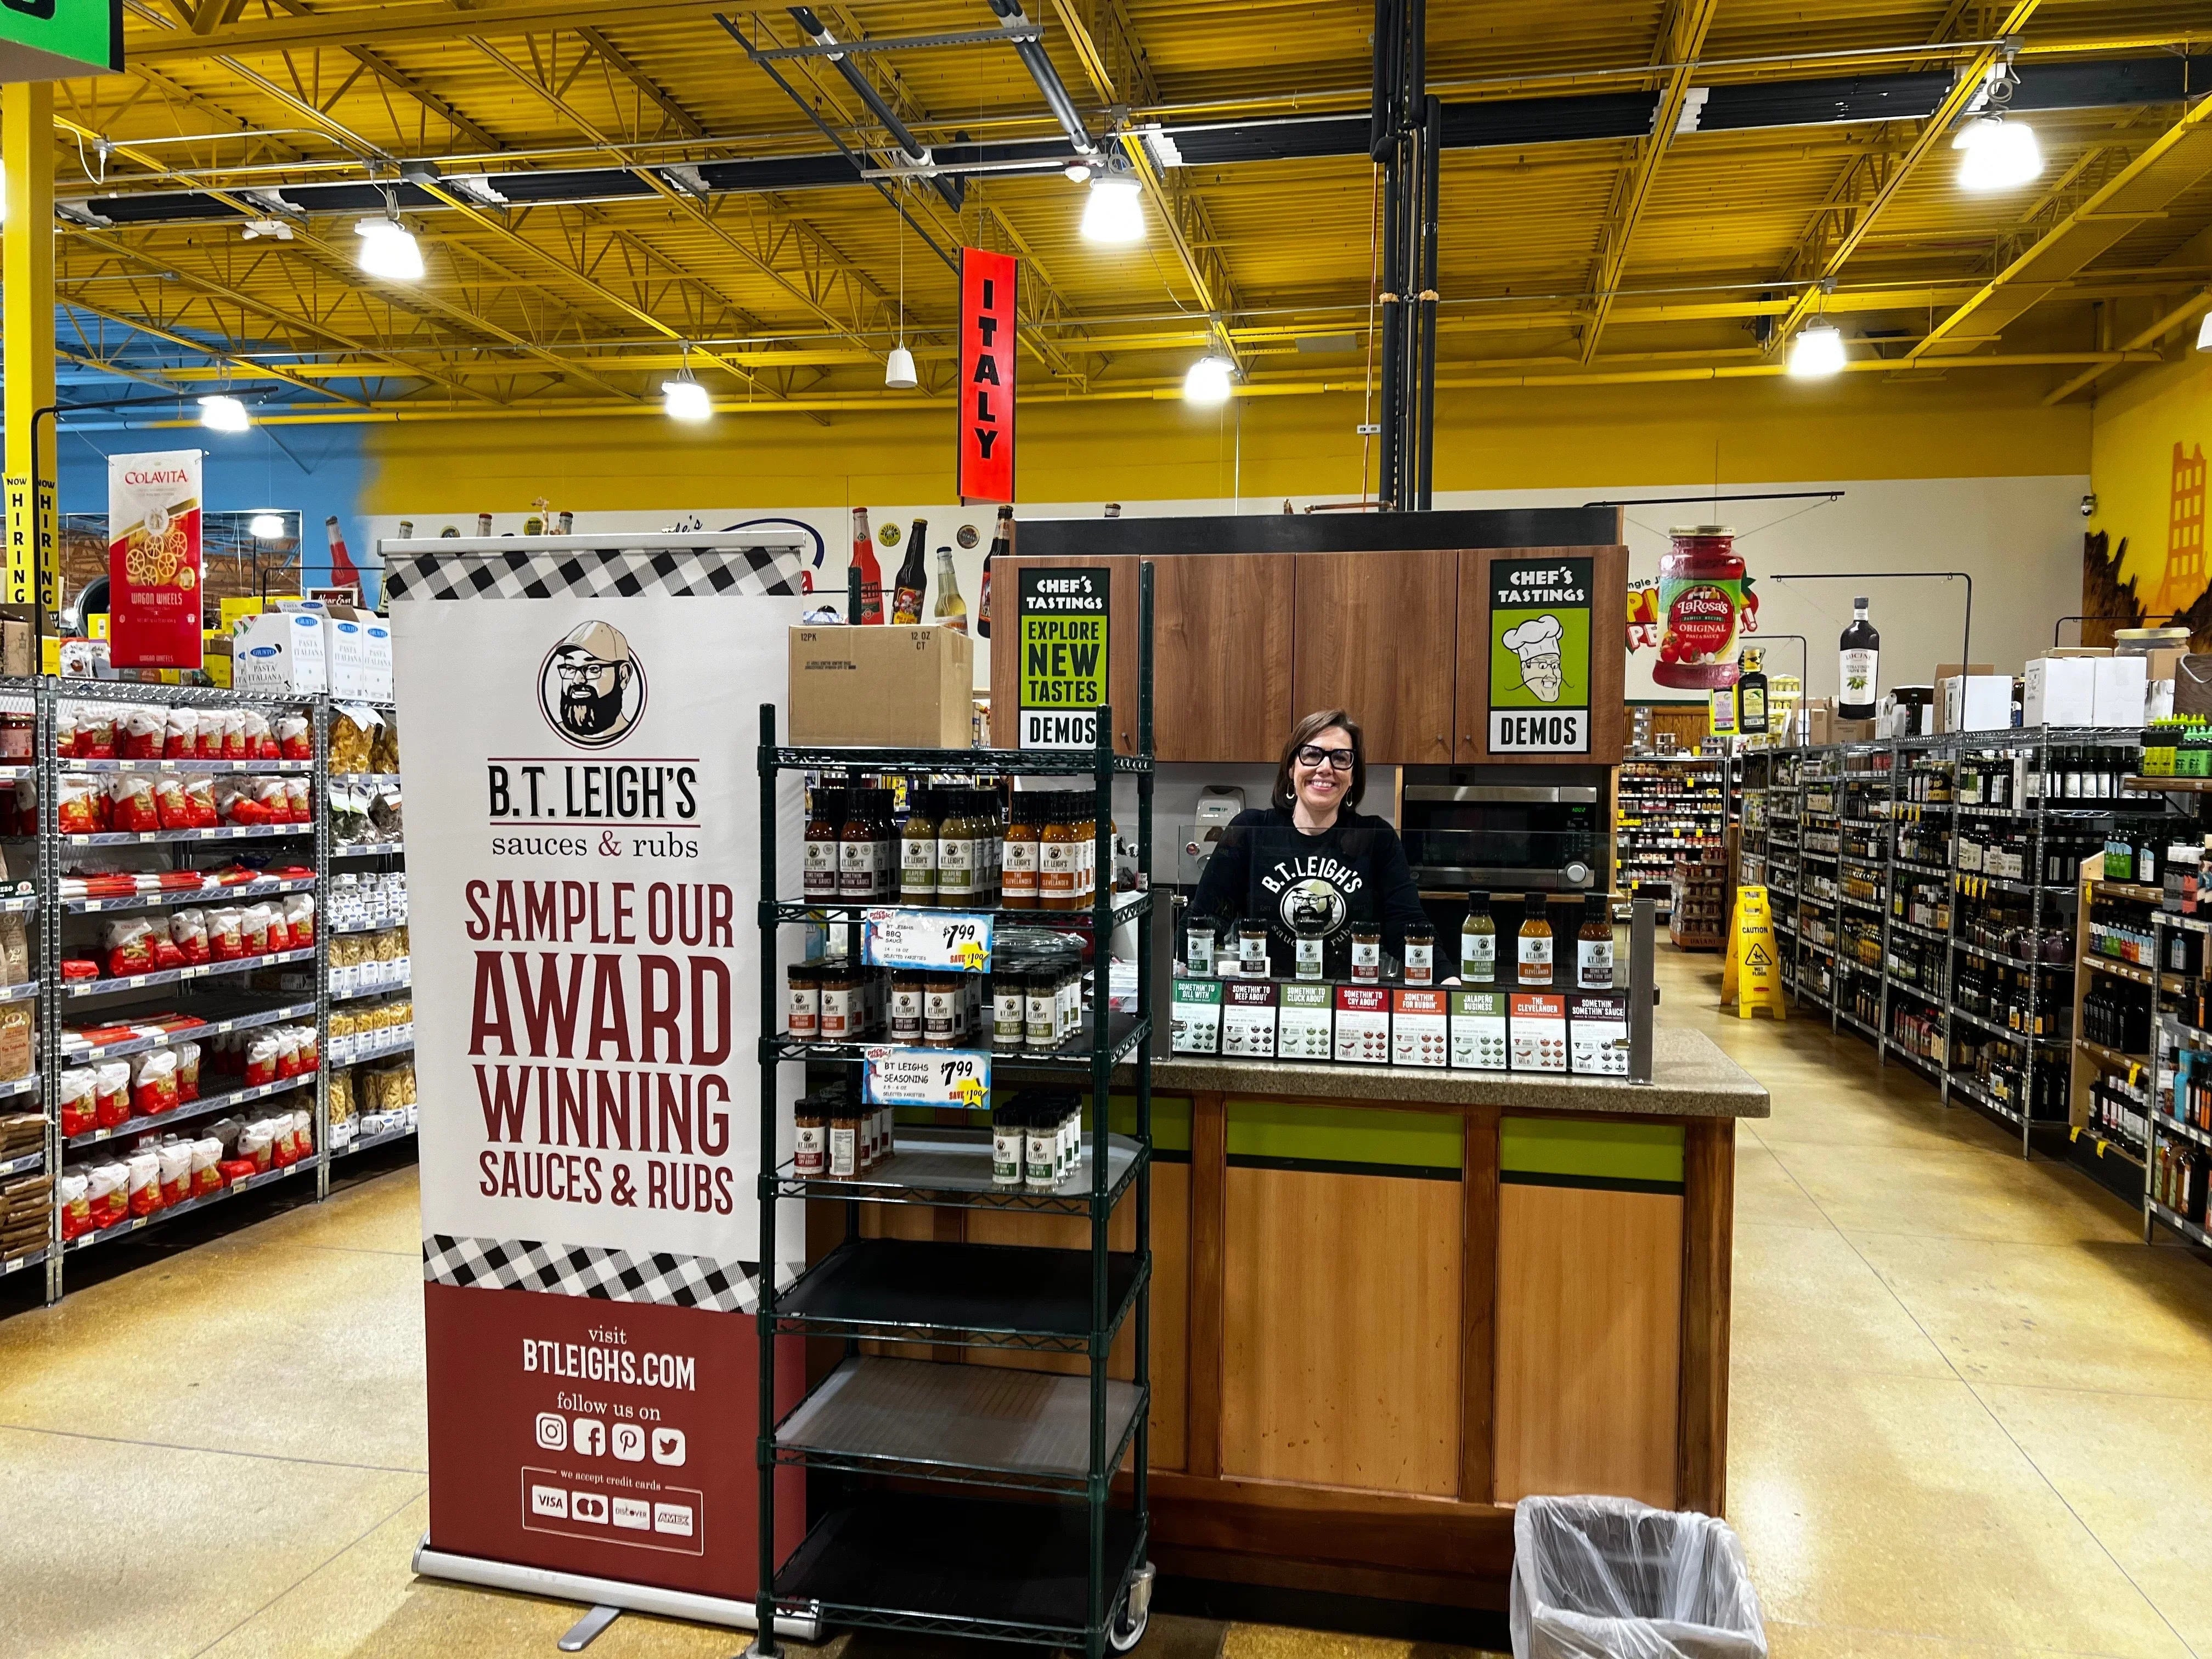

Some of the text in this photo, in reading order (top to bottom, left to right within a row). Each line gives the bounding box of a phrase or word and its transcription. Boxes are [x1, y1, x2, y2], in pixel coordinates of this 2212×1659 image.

[973, 279, 1000, 459] ITALY
[125, 469, 189, 485] COLAVITA
[12, 493, 25, 603] HIRING
[40, 494, 52, 605] HIRING
[1510, 566, 1573, 585] CHEF'S
[1037, 576, 1092, 593] CHEF'S
[131, 592, 183, 606] WAGON WHEELS
[1498, 588, 1585, 603] TASTINGS
[1027, 596, 1103, 611] TASTINGS
[1678, 600, 1728, 614] LaRosa's
[800, 633, 816, 641] 12PK
[922, 632, 930, 640] OZ
[1029, 621, 1099, 641] EXPLORE
[339, 645, 356, 653] PASTA
[916, 642, 926, 650] CT
[370, 650, 386, 658] PASTA
[1029, 643, 1100, 677] NEW
[249, 673, 282, 682] ITALIANA
[1029, 680, 1097, 703] TASTES
[1030, 717, 1096, 743] DEMOS
[1500, 717, 1577, 746] DEMOS
[488, 765, 697, 820] B.T. LEIGH'S
[493, 830, 698, 859] sauces & rubs
[1262, 856, 1363, 894] B.T. LEIGH'S
[465, 880, 733, 947] SAMPLE OUR
[886, 931, 901, 939] BBQ
[1271, 925, 1296, 947] sauc
[950, 955, 966, 963] SAVE
[1178, 983, 1207, 991] SOMETHIN'
[1232, 985, 1262, 994] SOMETHIN'
[1287, 987, 1325, 996] SOMETHIN' TO
[1344, 990, 1374, 999] SOMETHIN'
[1249, 993, 1267, 1001] ABOUT
[1359, 998, 1378, 1007] ABOUT
[1404, 993, 1435, 1002] SOMETHIN'
[1463, 994, 1493, 1003] JALAPEÑO
[1532, 997, 1543, 1005] THE
[1582, 1000, 1613, 1008] SOMETHIN'
[467, 951, 730, 1066] AWARD
[1464, 1002, 1493, 1011] BUSINESS
[1517, 1004, 1558, 1013] CLEVELANDER
[1572, 1007, 1605, 1015] SOMETHIN'
[1605, 1008, 1624, 1017] SAUCE
[884, 1062, 929, 1071] BT LEIGHS
[884, 1075, 929, 1084] SEASONING
[949, 1091, 964, 1100] SAVE
[472, 1064, 731, 1157] WINNING
[479, 1151, 734, 1216] SAUCES & RUBS
[588, 1325, 627, 1345] visit
[523, 1339, 696, 1391] BTLEIGHS.COM
[557, 1391, 661, 1421] follow us on
[561, 1470, 661, 1491] we accept credit cards
[538, 1493, 563, 1509] VISA
[657, 1511, 690, 1527] AMEX
